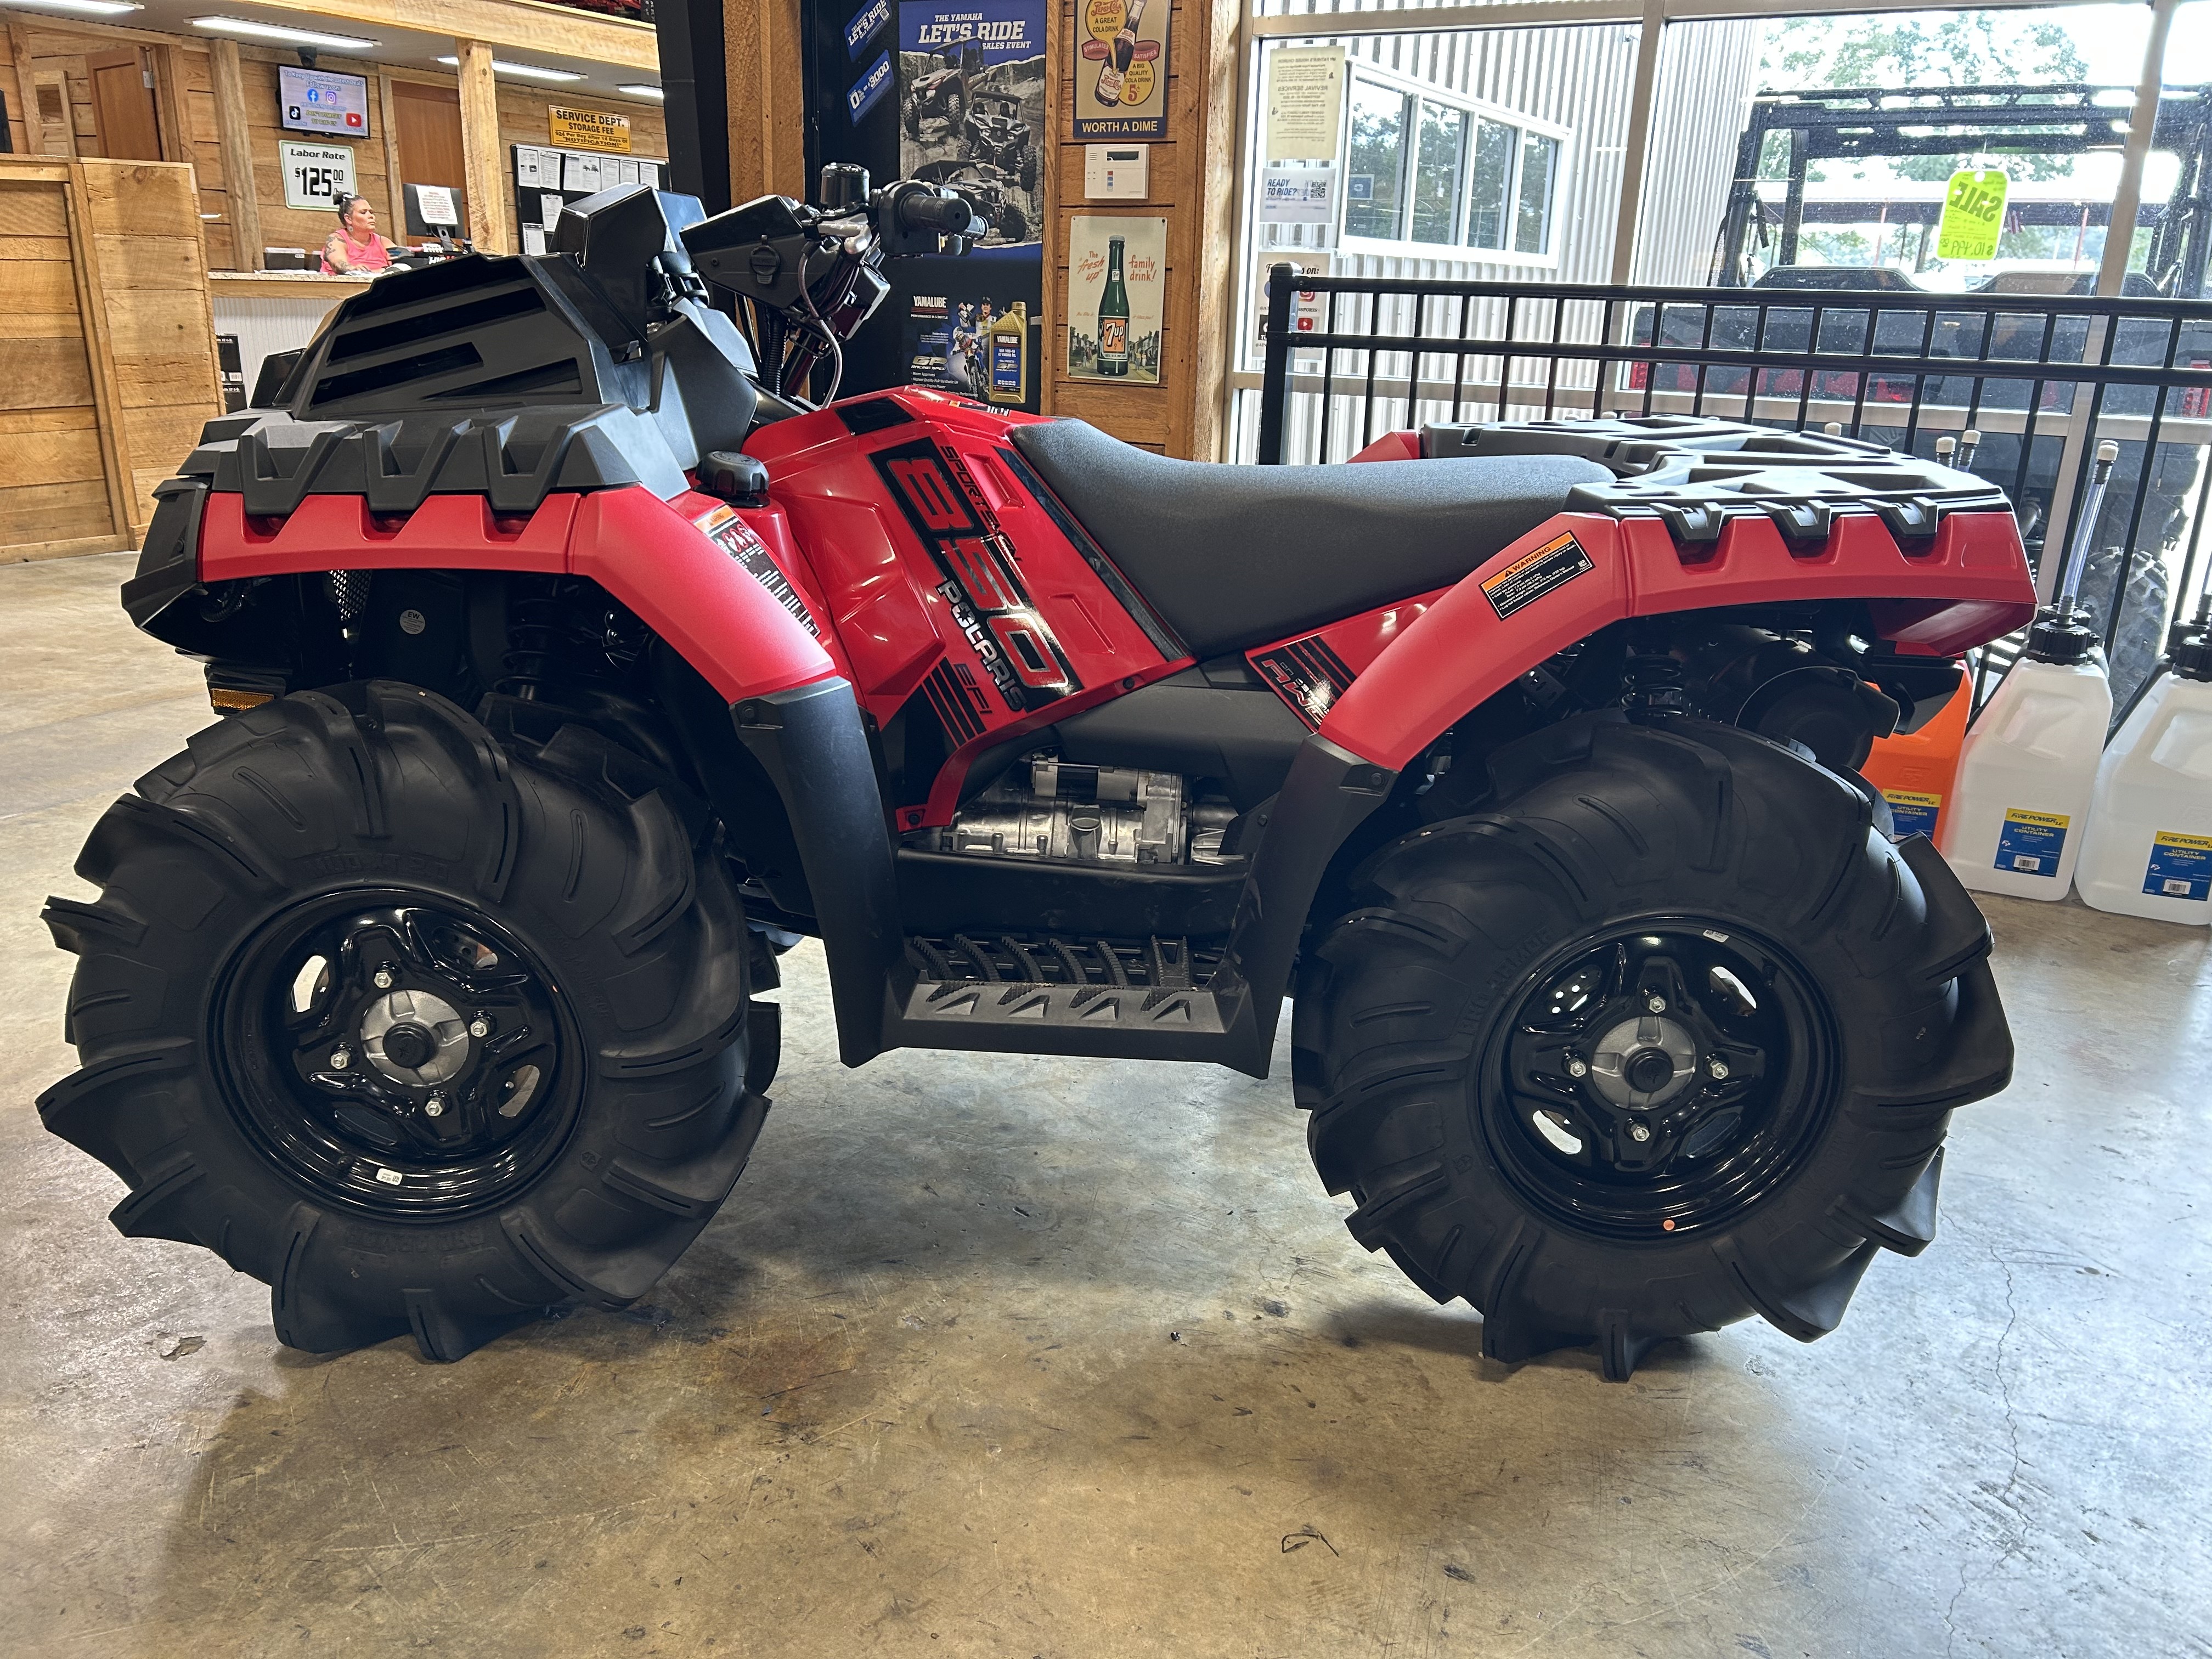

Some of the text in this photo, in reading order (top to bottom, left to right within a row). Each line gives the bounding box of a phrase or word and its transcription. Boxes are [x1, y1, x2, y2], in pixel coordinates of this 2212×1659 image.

[951, 13, 983, 21] YAMAHA
[848, 18, 868, 46] LET'S
[918, 20, 1025, 43] LET'S RIDE
[1084, 43, 1109, 53] STIMULATES
[1133, 49, 1157, 59] SATISFIES
[556, 110, 624, 128] SERVICE DEPT.
[568, 122, 601, 133] STORAGE
[1082, 121, 1158, 133] WORTH A DIME
[290, 148, 345, 160] Labor Rate
[1267, 179, 1290, 187] READY
[1267, 188, 1276, 196] TO
[1277, 188, 1297, 196] RIDE?
[1128, 255, 1155, 272] family
[1130, 269, 1157, 283] drink!
[913, 296, 946, 308] YAMALUBE
[997, 335, 1018, 343] YAMALUBE
[912, 356, 947, 366] GP
[1513, 546, 1551, 572] WARNING
[887, 458, 1069, 689] 850
[938, 580, 1027, 712] POLARIS
[1280, 662, 1294, 676] on
[954, 664, 992, 714] EFI
[2029, 815, 2057, 823] POWER
[2014, 828, 2055, 837] CONTAINER
[2164, 851, 2206, 860] CONTAINER
